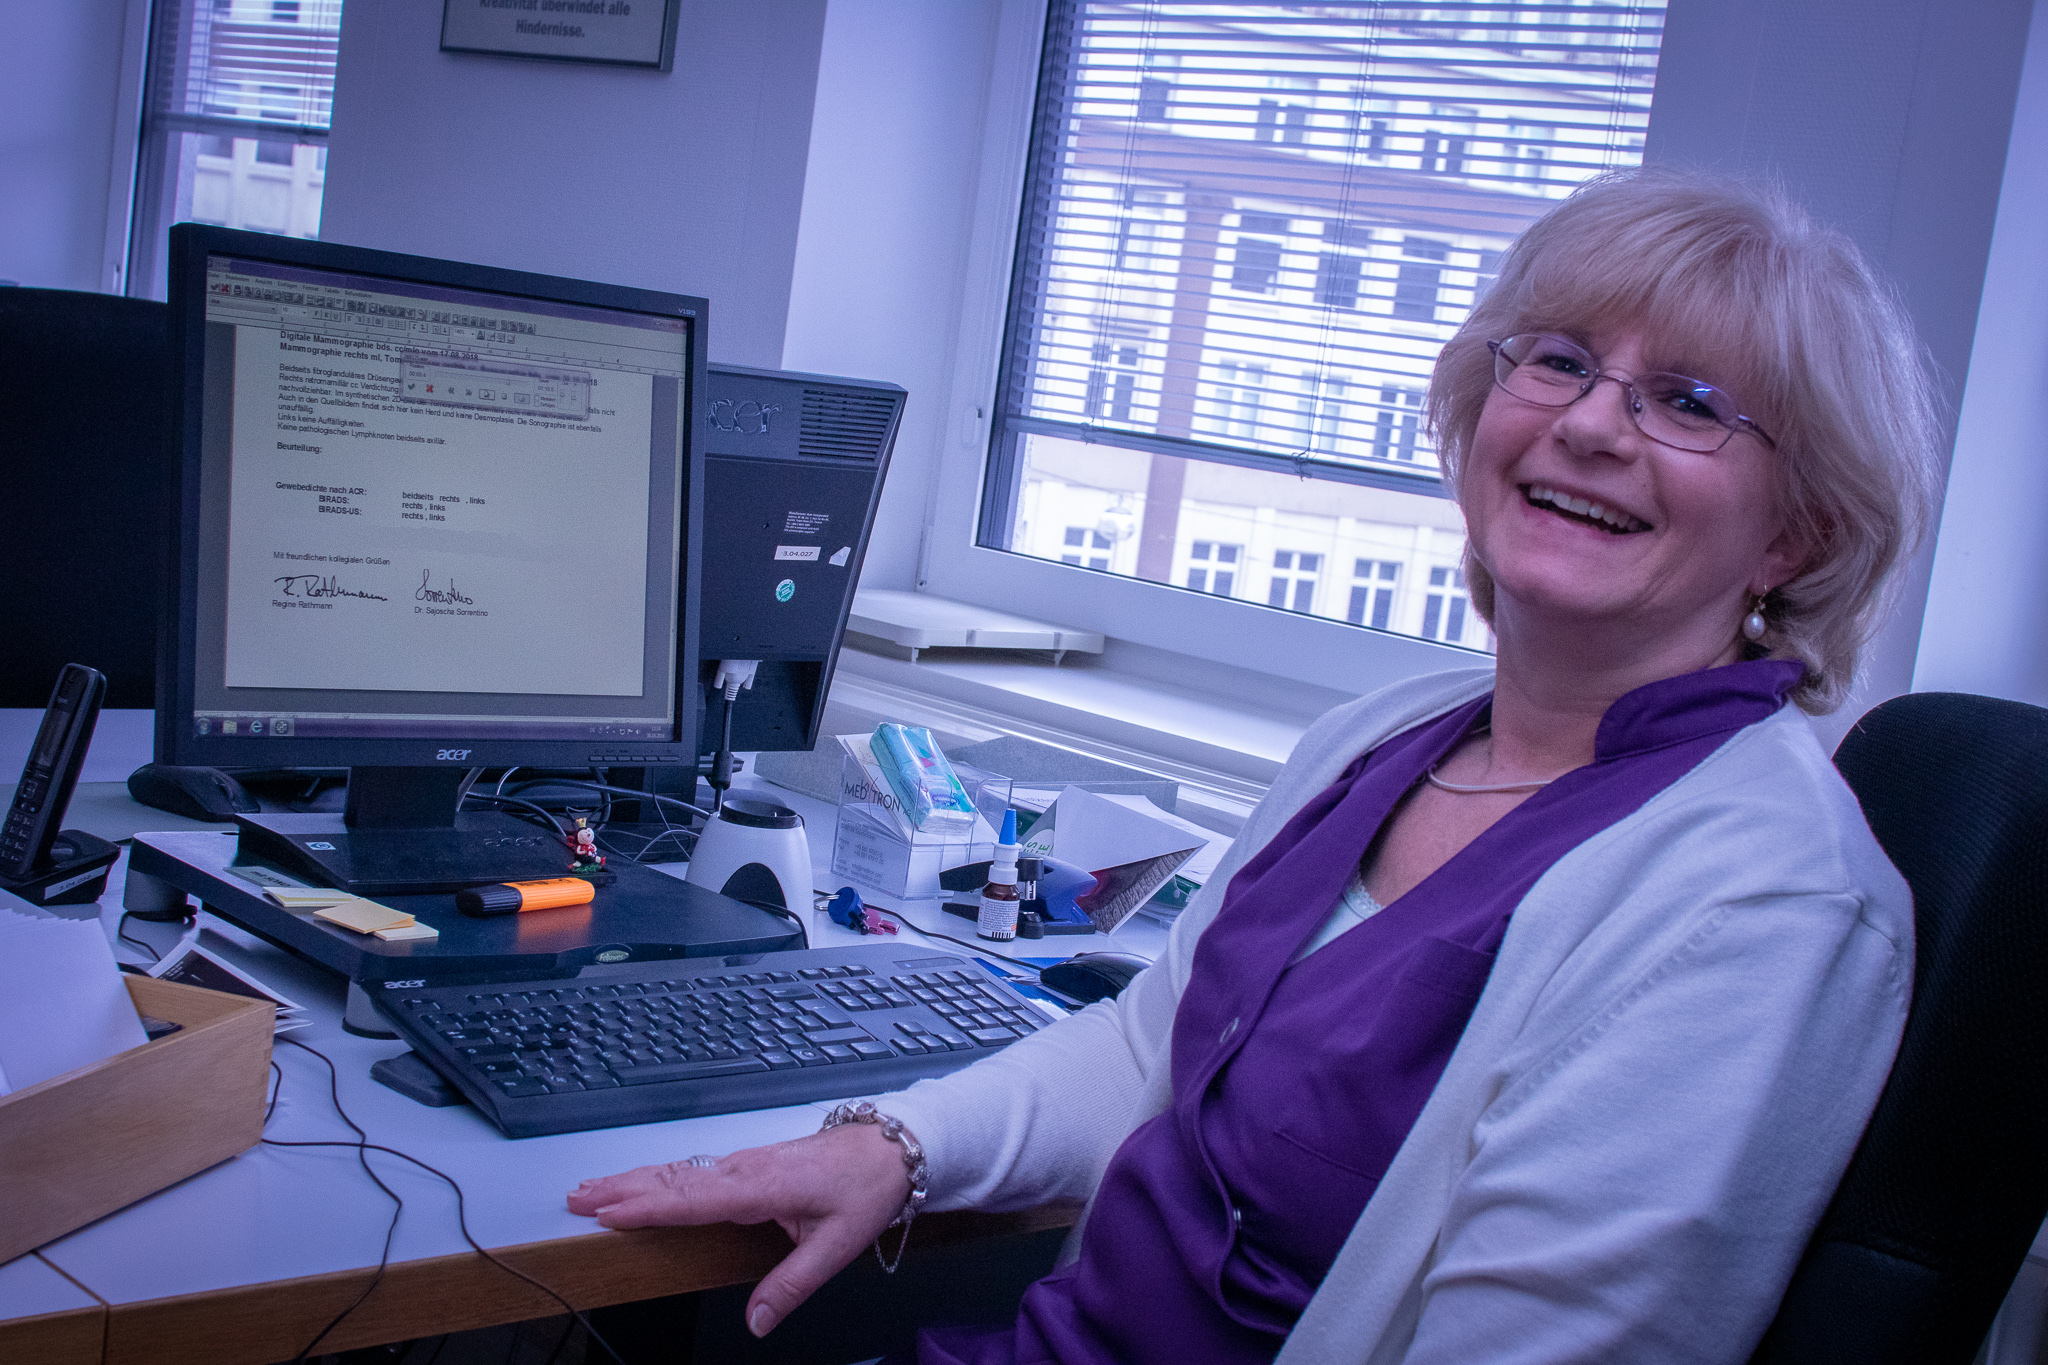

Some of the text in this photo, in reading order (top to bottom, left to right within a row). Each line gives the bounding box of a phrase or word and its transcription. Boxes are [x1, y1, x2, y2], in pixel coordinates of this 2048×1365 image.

[608, 2, 631, 16] alle
[515, 19, 586, 38] Hindernisse.
[280, 331, 311, 342] Digitale
[313, 334, 374, 350] Mammographie
[376, 343, 393, 352] bds.
[280, 342, 342, 357] Mammographie
[344, 350, 369, 360] rechts
[279, 363, 311, 374] Beidseits
[279, 373, 303, 384] Rechts
[334, 389, 344, 397] Im
[345, 390, 390, 403] synthetischen
[278, 393, 296, 402] Auch
[306, 396, 318, 404] den
[320, 397, 360, 409] Quellbildern
[361, 401, 380, 411] findet
[381, 403, 396, 412] sich
[396, 404, 408, 413] hier
[410, 406, 423, 415] kein
[425, 407, 441, 417] Herd
[442, 409, 454, 418] und
[456, 411, 473, 420] keine
[517, 418, 528, 426] Die
[528, 419, 566, 430] Sonographie
[576, 424, 602, 433] ebenfalls
[278, 413, 296, 422] Links
[298, 415, 316, 424] keine
[706, 399, 784, 436] cer
[277, 422, 298, 431] Keine
[298, 425, 350, 438] pathologischen
[351, 429, 395, 441] Lymphknoten
[396, 434, 425, 444] beidseits
[276, 441, 322, 454] Beurteilung:
[276, 481, 327, 493] Gewebedichte
[329, 486, 347, 494] nach
[348, 487, 367, 496] ACR:
[402, 491, 434, 501] beidseits
[439, 494, 460, 503] rechts
[318, 495, 350, 504] BIRADS:
[402, 501, 423, 510] rechts
[429, 503, 446, 512] links
[318, 505, 362, 516] BIRADS-US:
[402, 511, 423, 520] rechts
[429, 513, 446, 522] links
[273, 551, 391, 566] Mit freundlichen kollegialen Grüßen
[272, 599, 333, 610] Regine Rathmann
[414, 606, 423, 614] Dr.
[456, 609, 489, 618] Sorrentino
[436, 749, 472, 761] acer
[384, 979, 426, 990] acer
